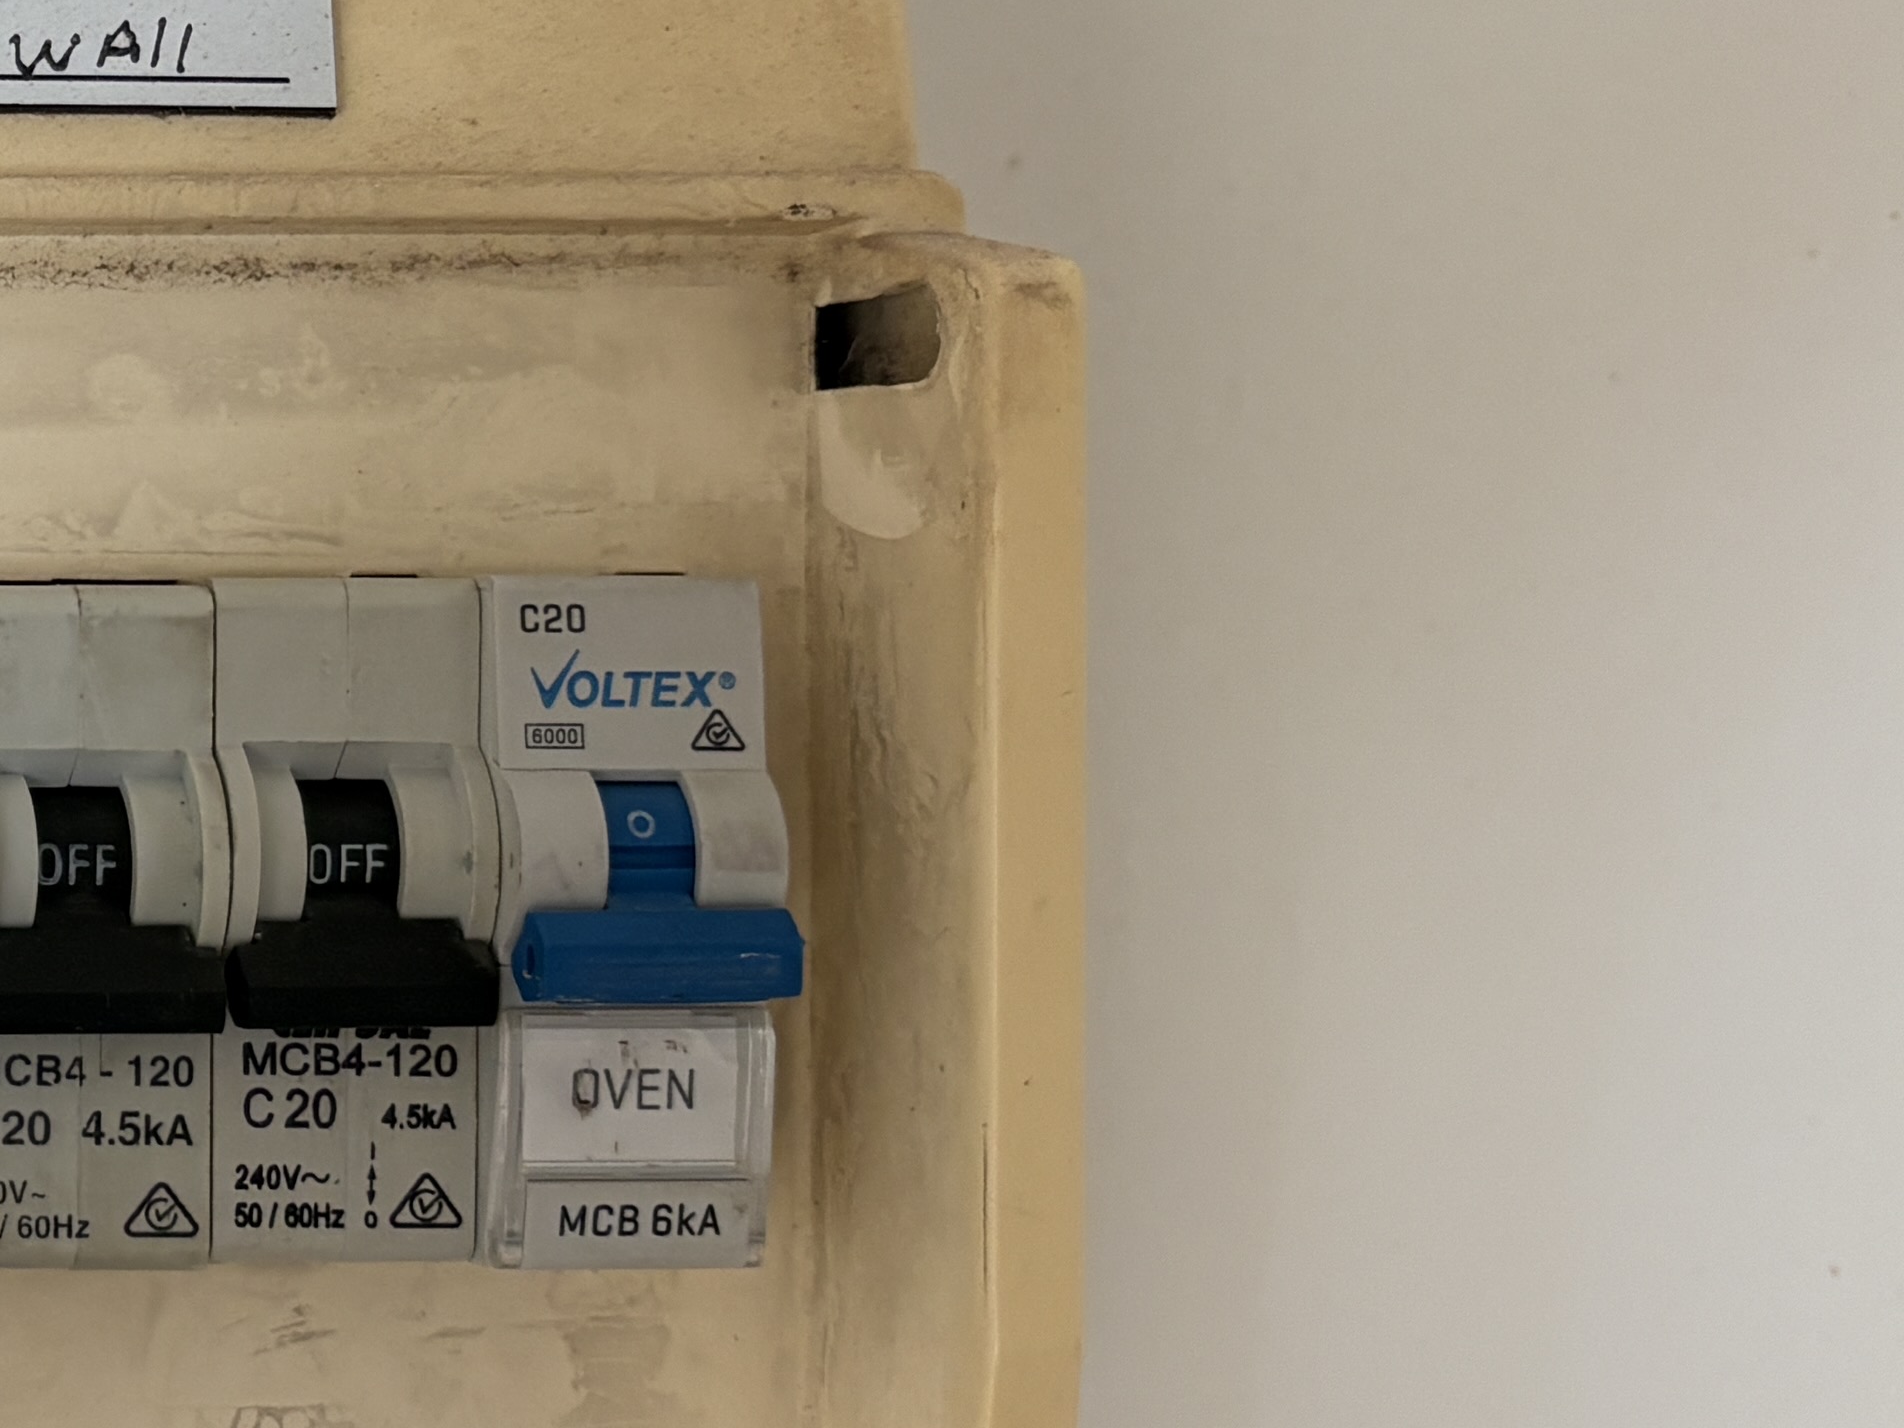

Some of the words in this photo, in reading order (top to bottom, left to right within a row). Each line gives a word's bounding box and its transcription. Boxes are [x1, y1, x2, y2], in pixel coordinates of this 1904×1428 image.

[519, 604, 586, 634] C20
[532, 727, 578, 745] 6000
[38, 843, 117, 886] OFF
[309, 843, 389, 886] OFF
[242, 1042, 458, 1077] MCB4-120
[572, 1068, 695, 1110] OVEN
[82, 1111, 193, 1146] 4.5kA
[381, 1103, 456, 1130] 4.5kA
[559, 1204, 639, 1237] MCB
[651, 1203, 720, 1236] 6kA
